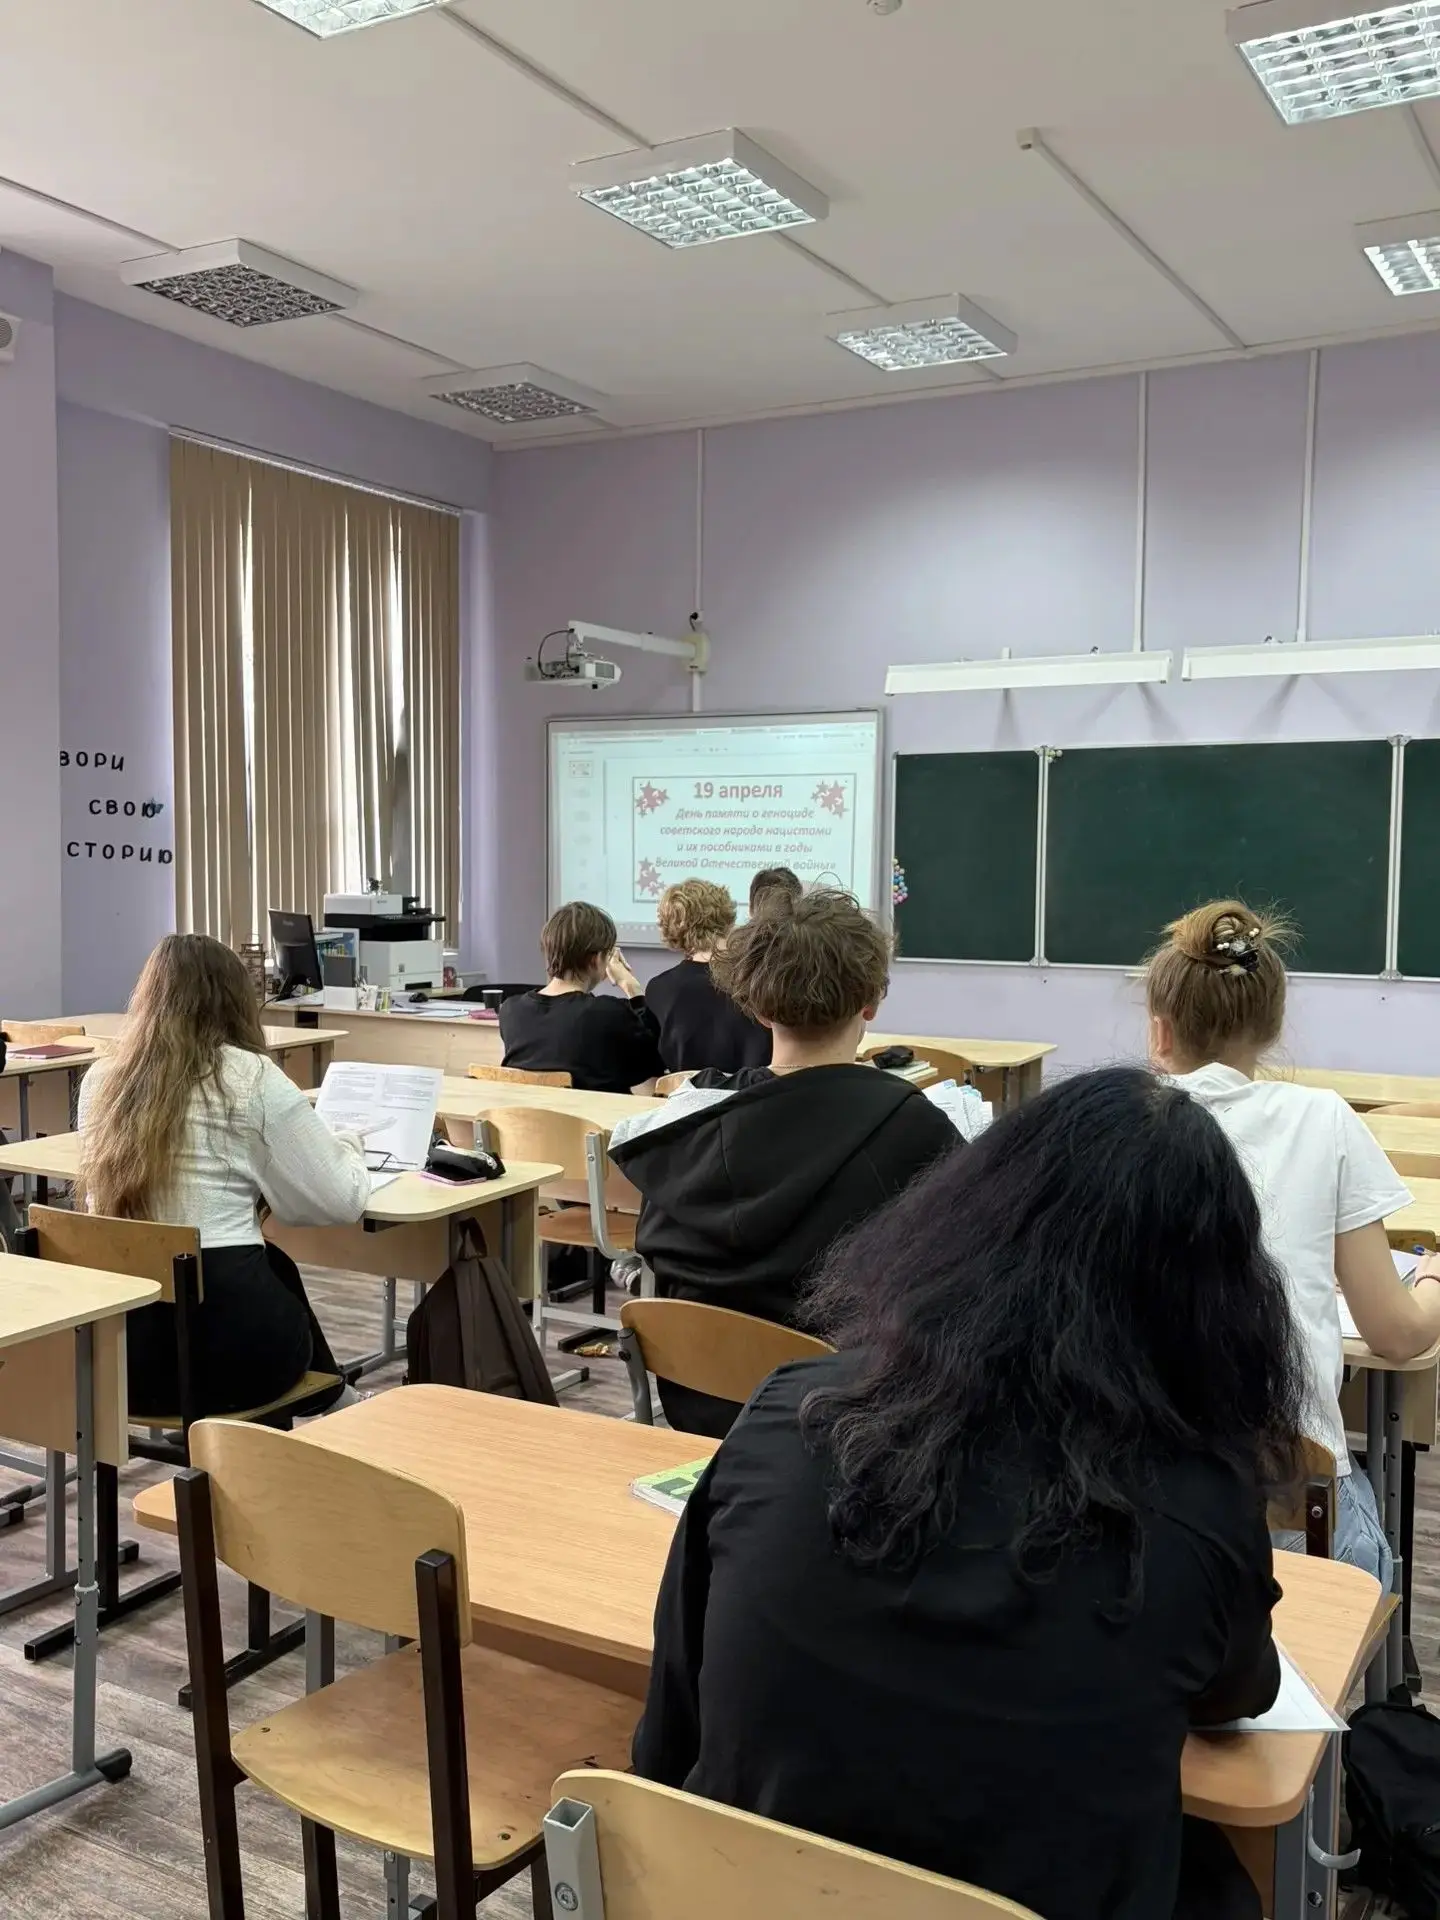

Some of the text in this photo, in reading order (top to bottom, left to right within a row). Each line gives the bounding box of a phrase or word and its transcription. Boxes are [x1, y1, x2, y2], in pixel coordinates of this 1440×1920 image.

[60, 750, 124, 771] ВОРИ
[694, 782, 783, 803] 19 апреля
[675, 807, 815, 820] День памяти о геноциде
[660, 826, 721, 836] советского
[765, 827, 832, 837] нацистами
[67, 841, 172, 864] СТОРИЮ
[677, 841, 813, 852] и их пособниками в годы
